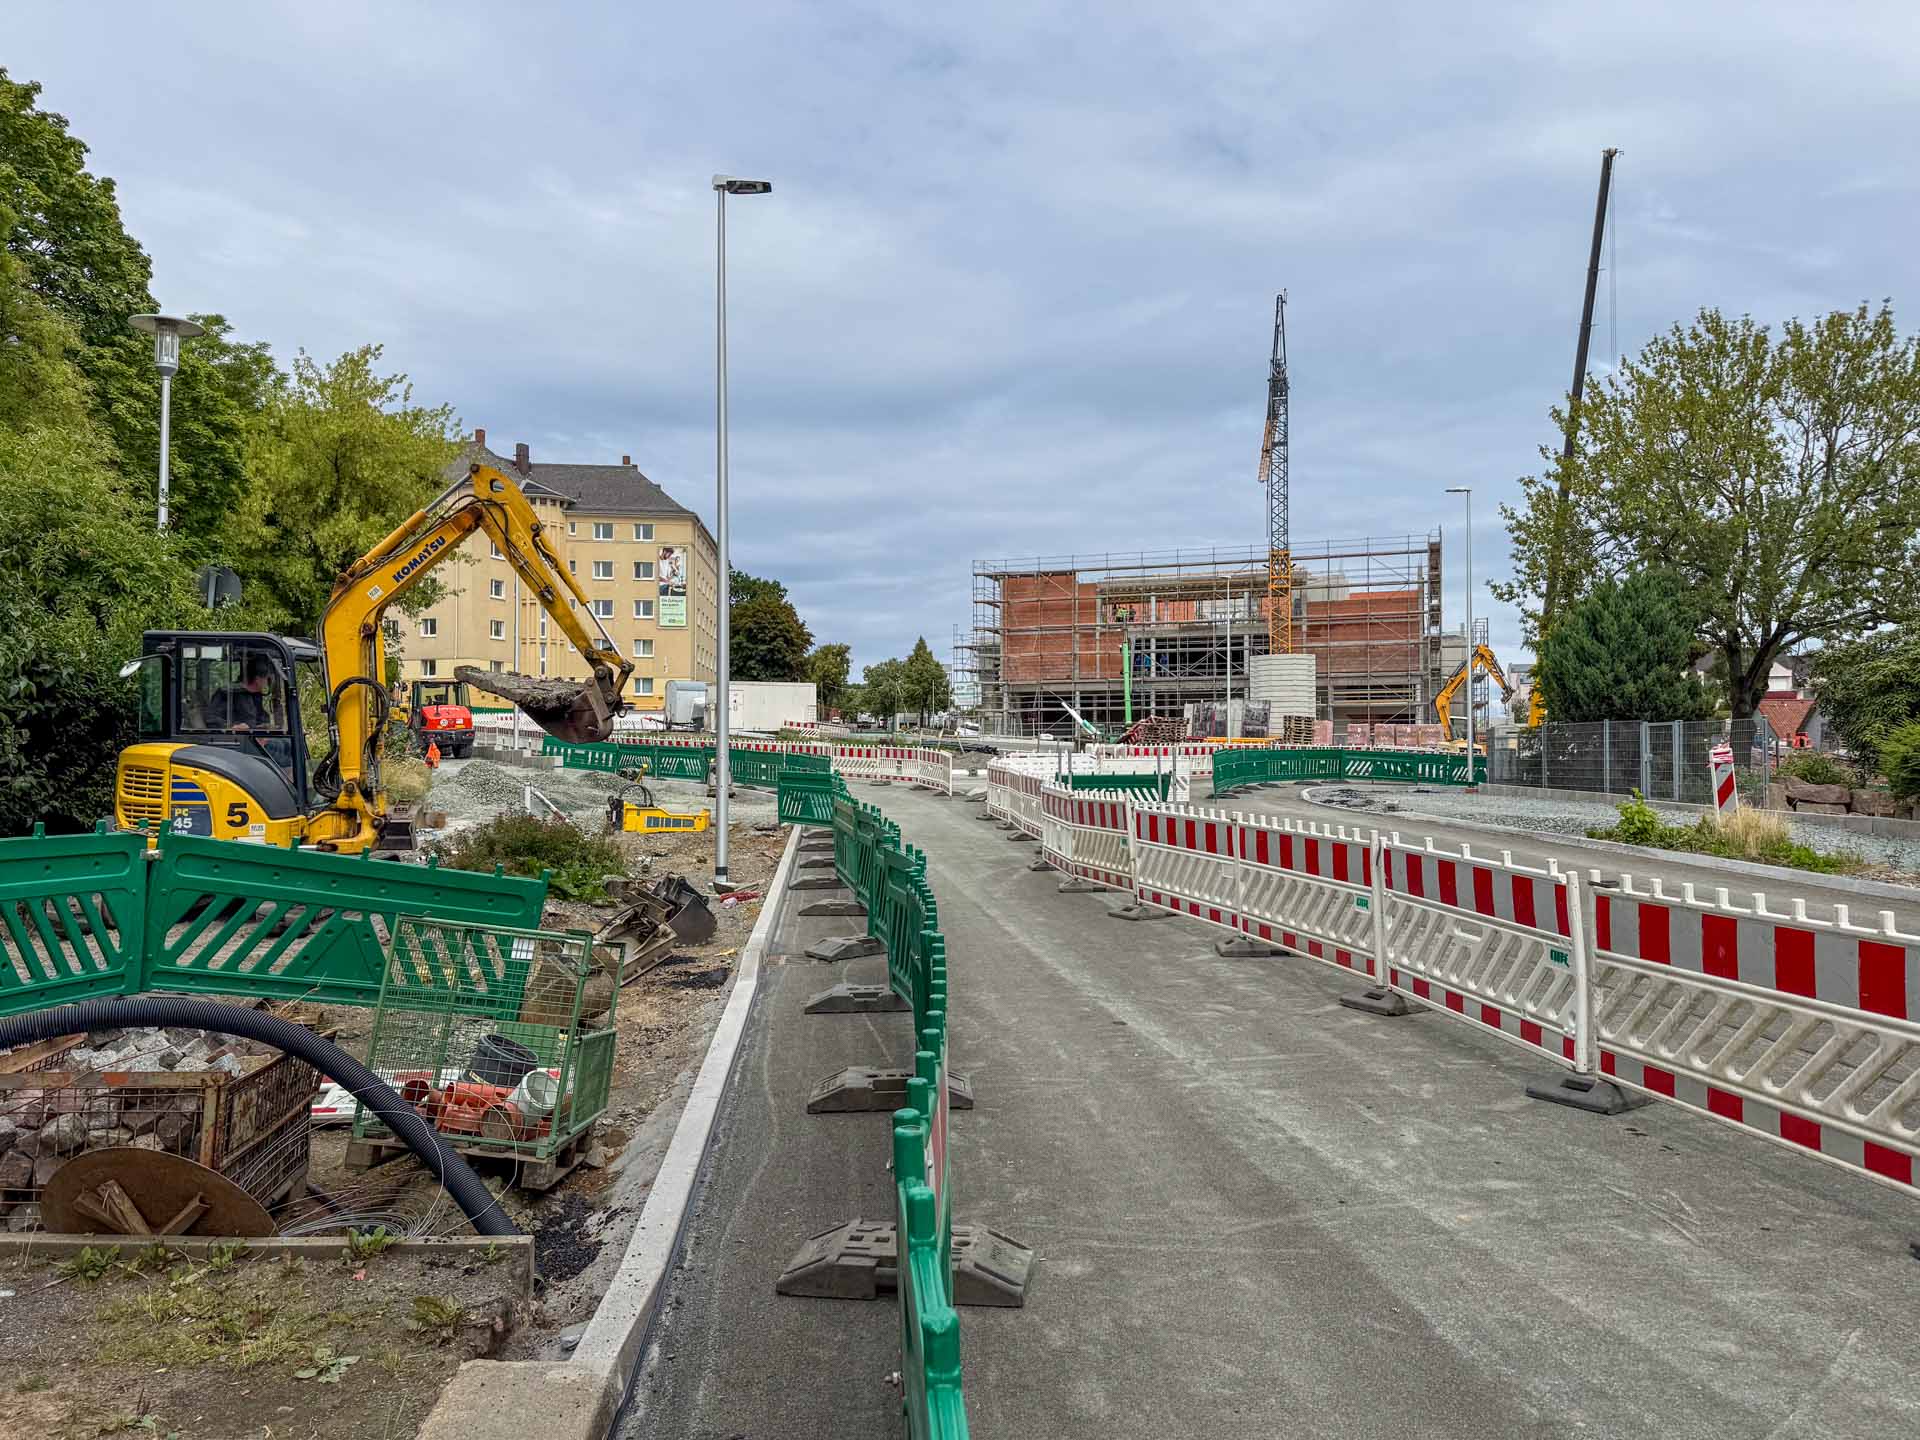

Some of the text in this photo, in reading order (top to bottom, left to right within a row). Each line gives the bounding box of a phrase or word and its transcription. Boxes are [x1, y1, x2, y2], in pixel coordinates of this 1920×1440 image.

[392, 535, 446, 583] KOMATSU
[174, 808, 189, 817] PC
[226, 802, 250, 828] 5
[173, 817, 193, 829] 45
